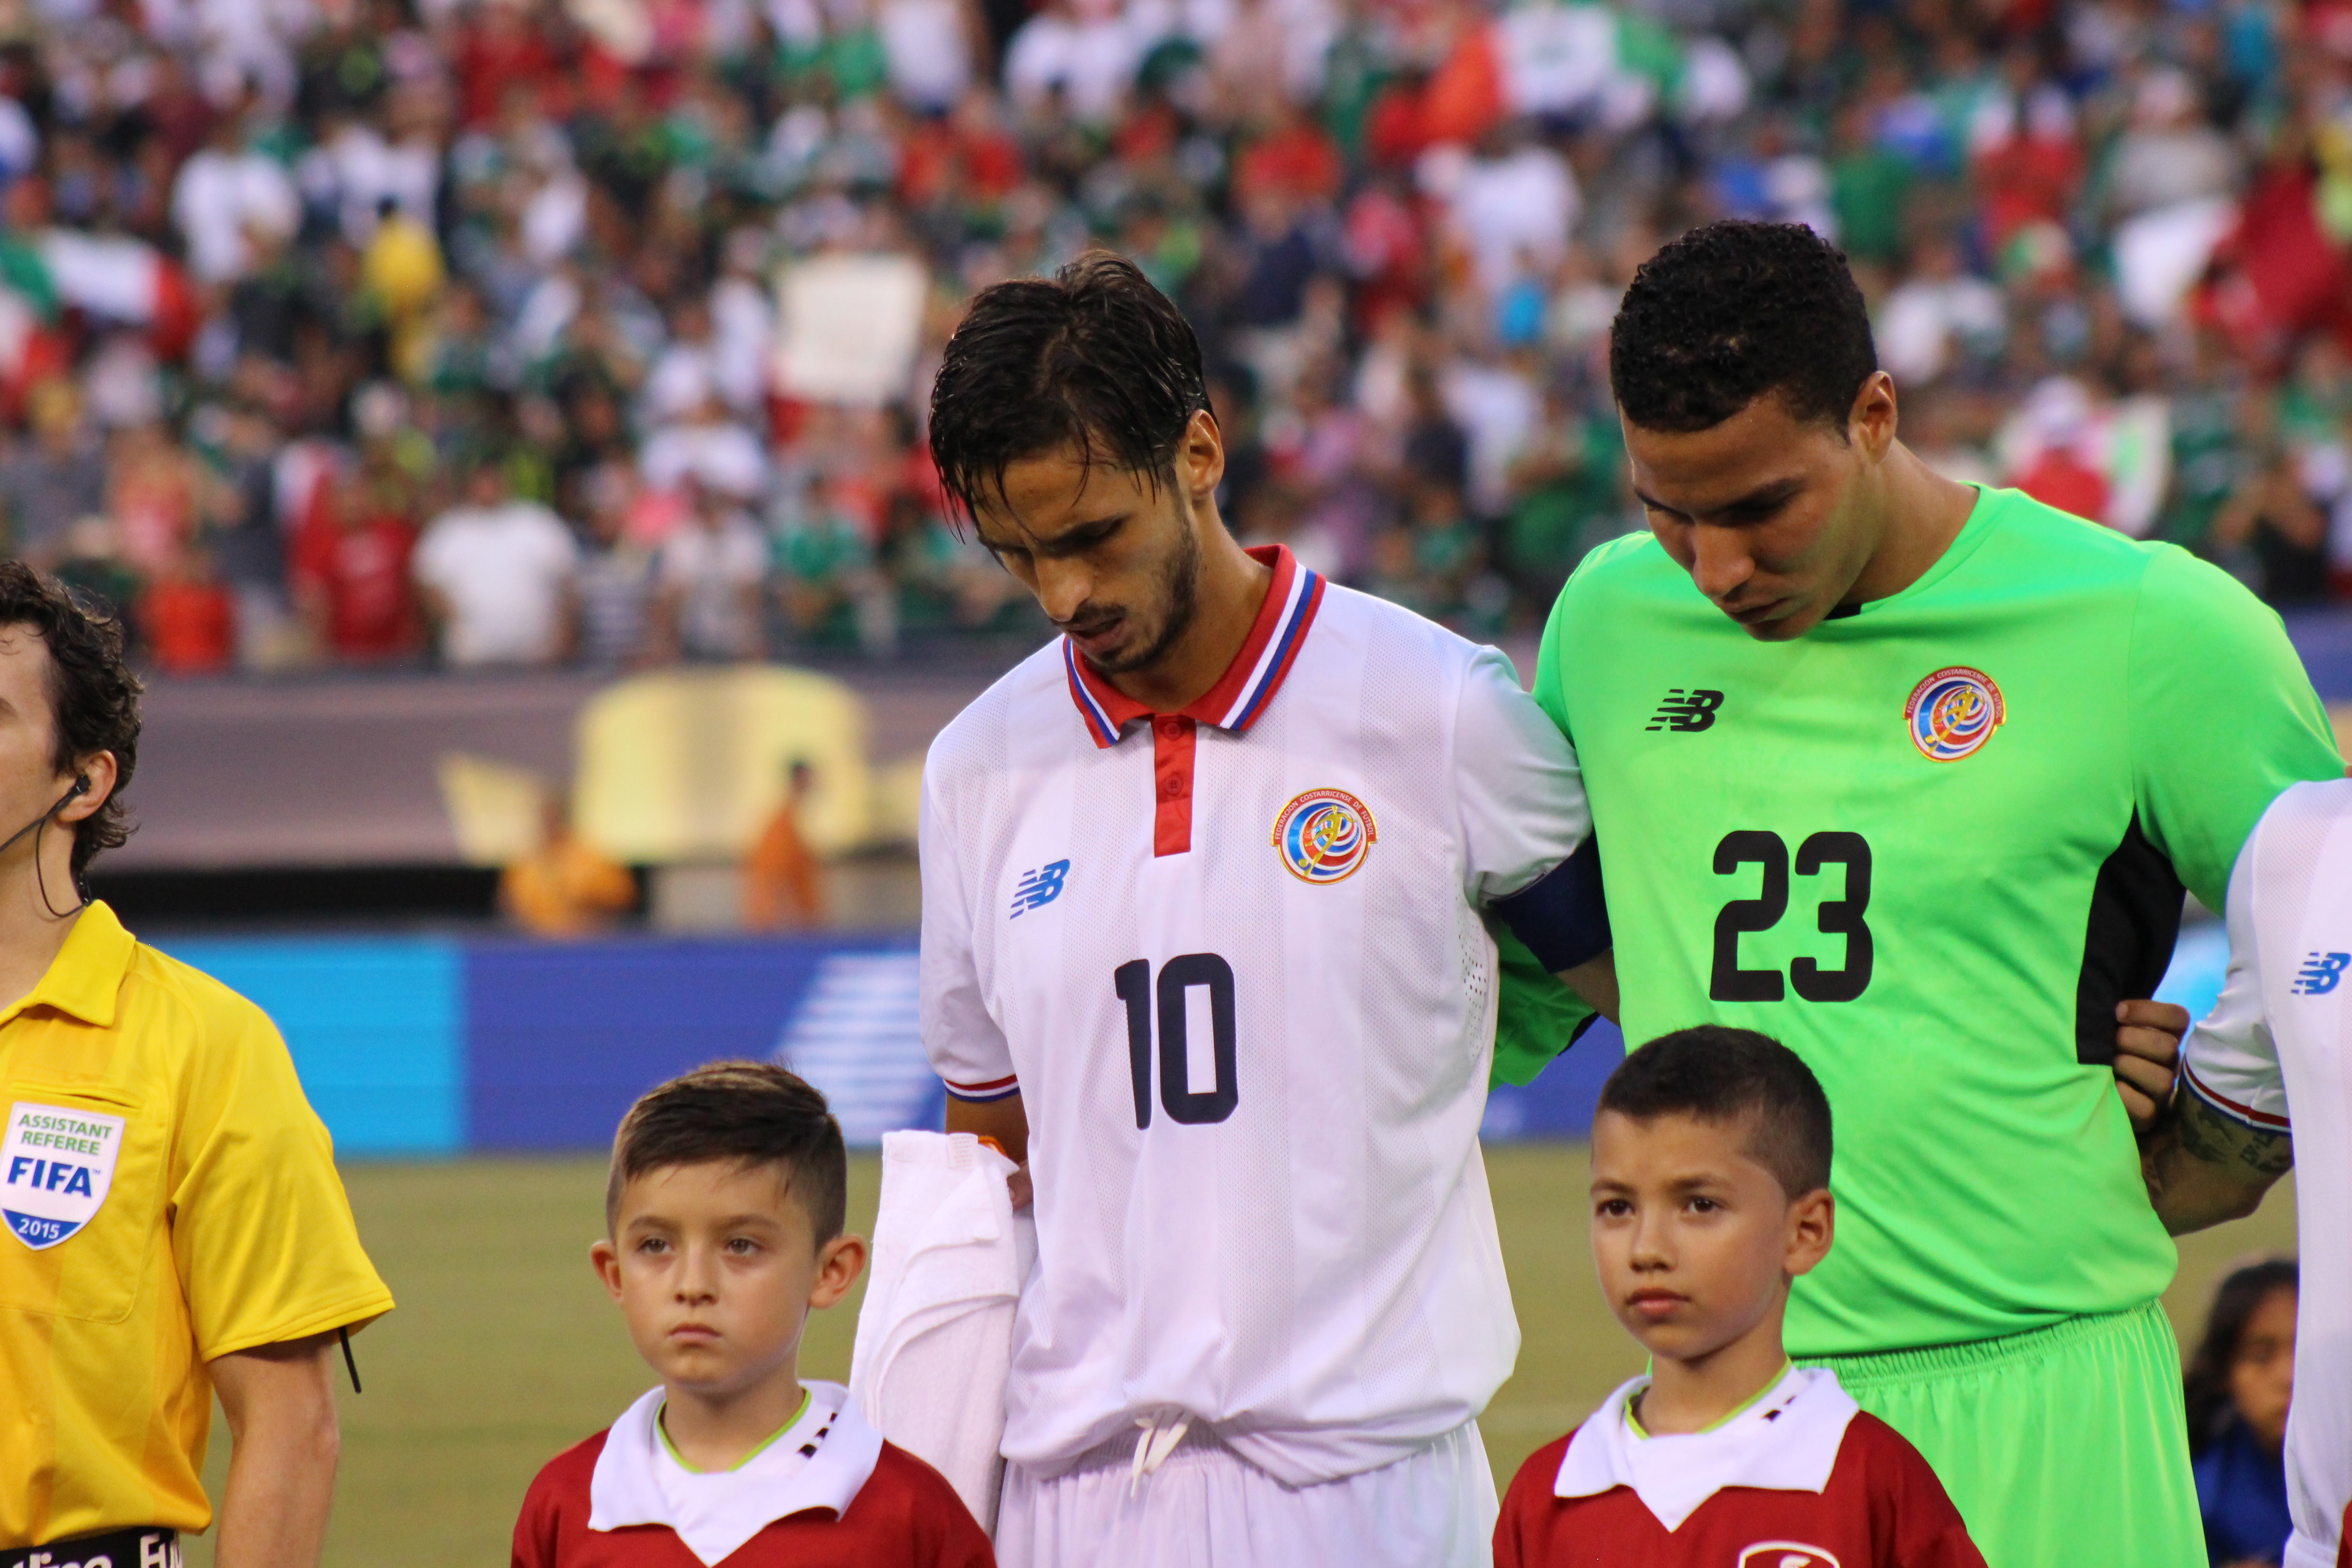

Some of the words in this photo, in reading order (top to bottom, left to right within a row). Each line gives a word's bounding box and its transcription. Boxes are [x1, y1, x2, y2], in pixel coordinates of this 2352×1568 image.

[1274, 801, 1299, 840] FEDERACION
[1299, 791, 1353, 804] COSTARRICENSE
[1352, 801, 1362, 811] DE
[1361, 810, 1374, 836] FUTBOL
[1710, 830, 1874, 1002] 23
[1114, 953, 1238, 1130] 10
[19, 1114, 113, 1139] ASSISTANT
[21, 1131, 100, 1155] REFEREE
[7, 1156, 92, 1198] FIFA
[18, 1218, 60, 1239] 2015
